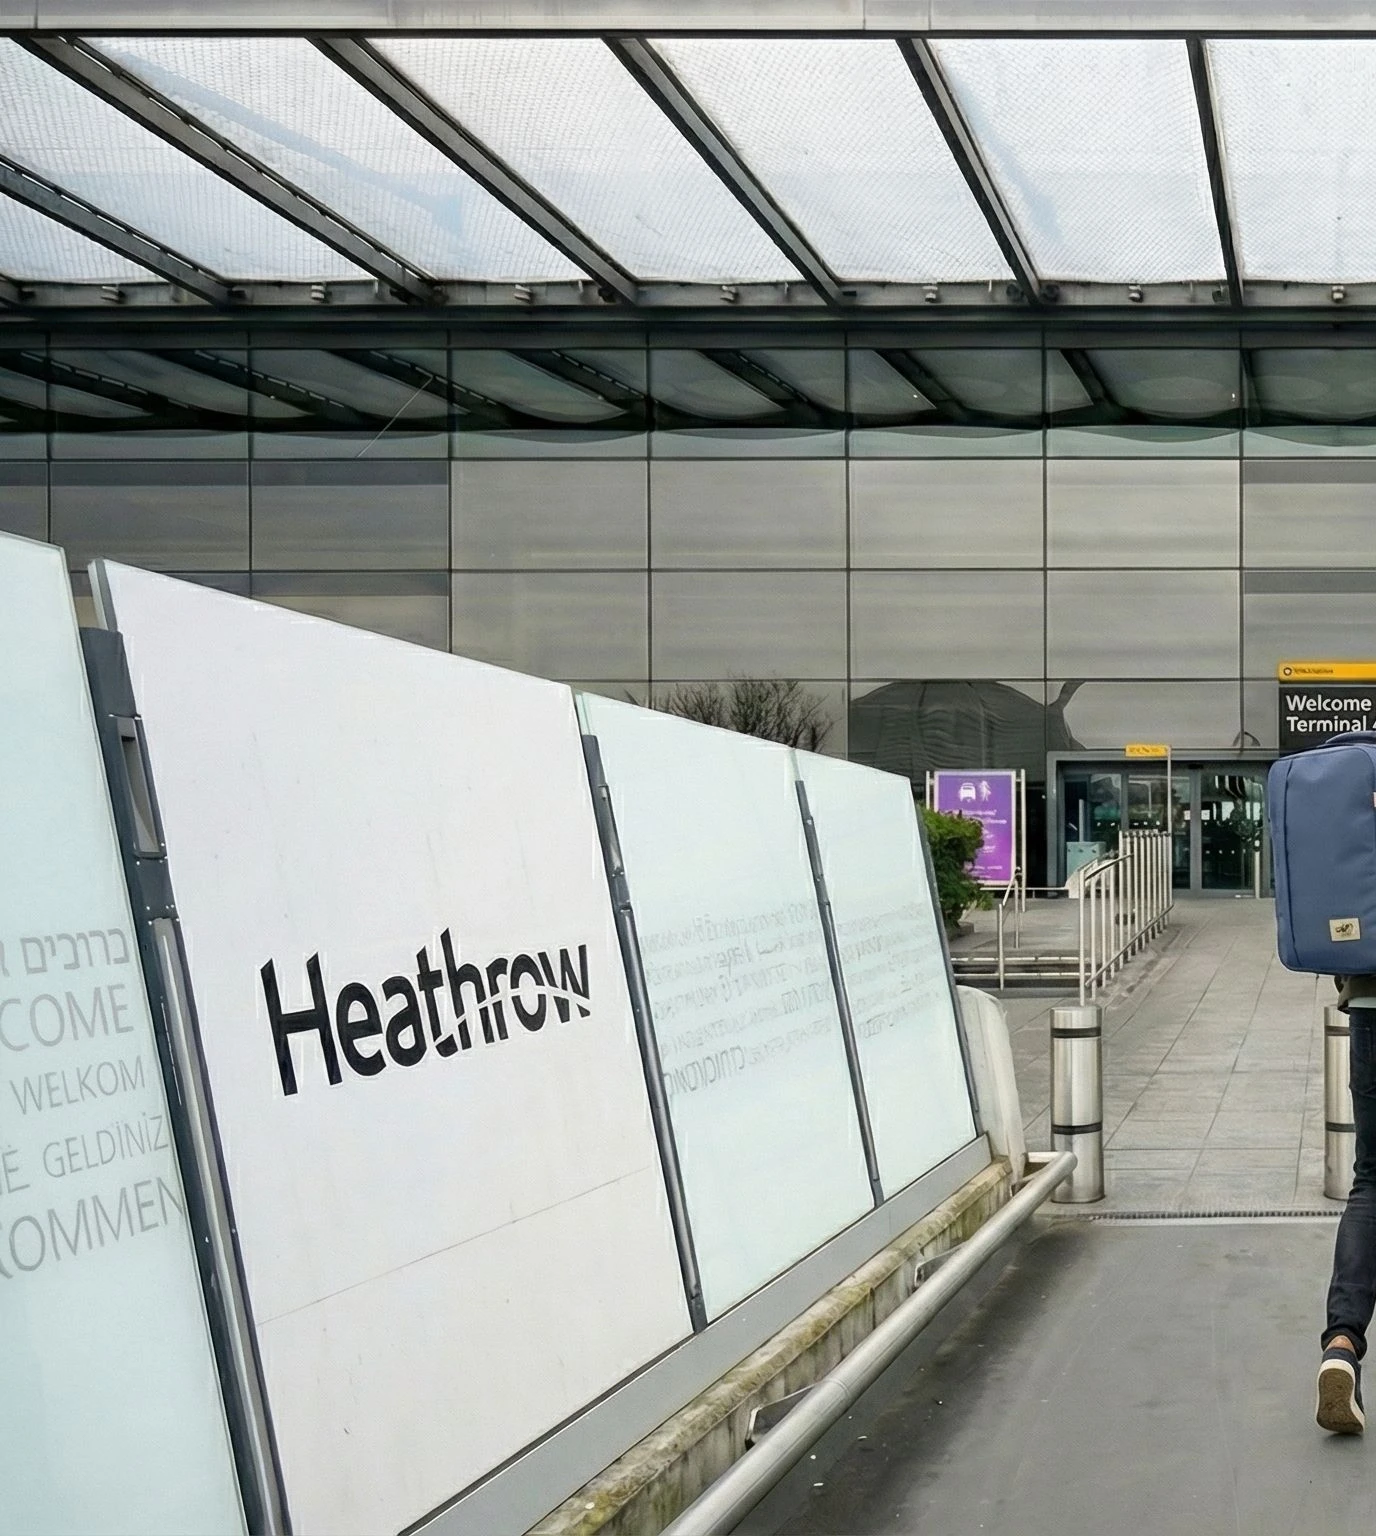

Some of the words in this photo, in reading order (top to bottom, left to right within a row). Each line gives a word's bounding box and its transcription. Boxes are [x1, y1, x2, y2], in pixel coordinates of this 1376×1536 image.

[1285, 694, 1372, 712] Welcome
[1285, 715, 1367, 732] Terminal
[0, 983, 134, 1052] COME
[260, 927, 591, 1096] Heathrow
[9, 1055, 146, 1116] WELKOM
